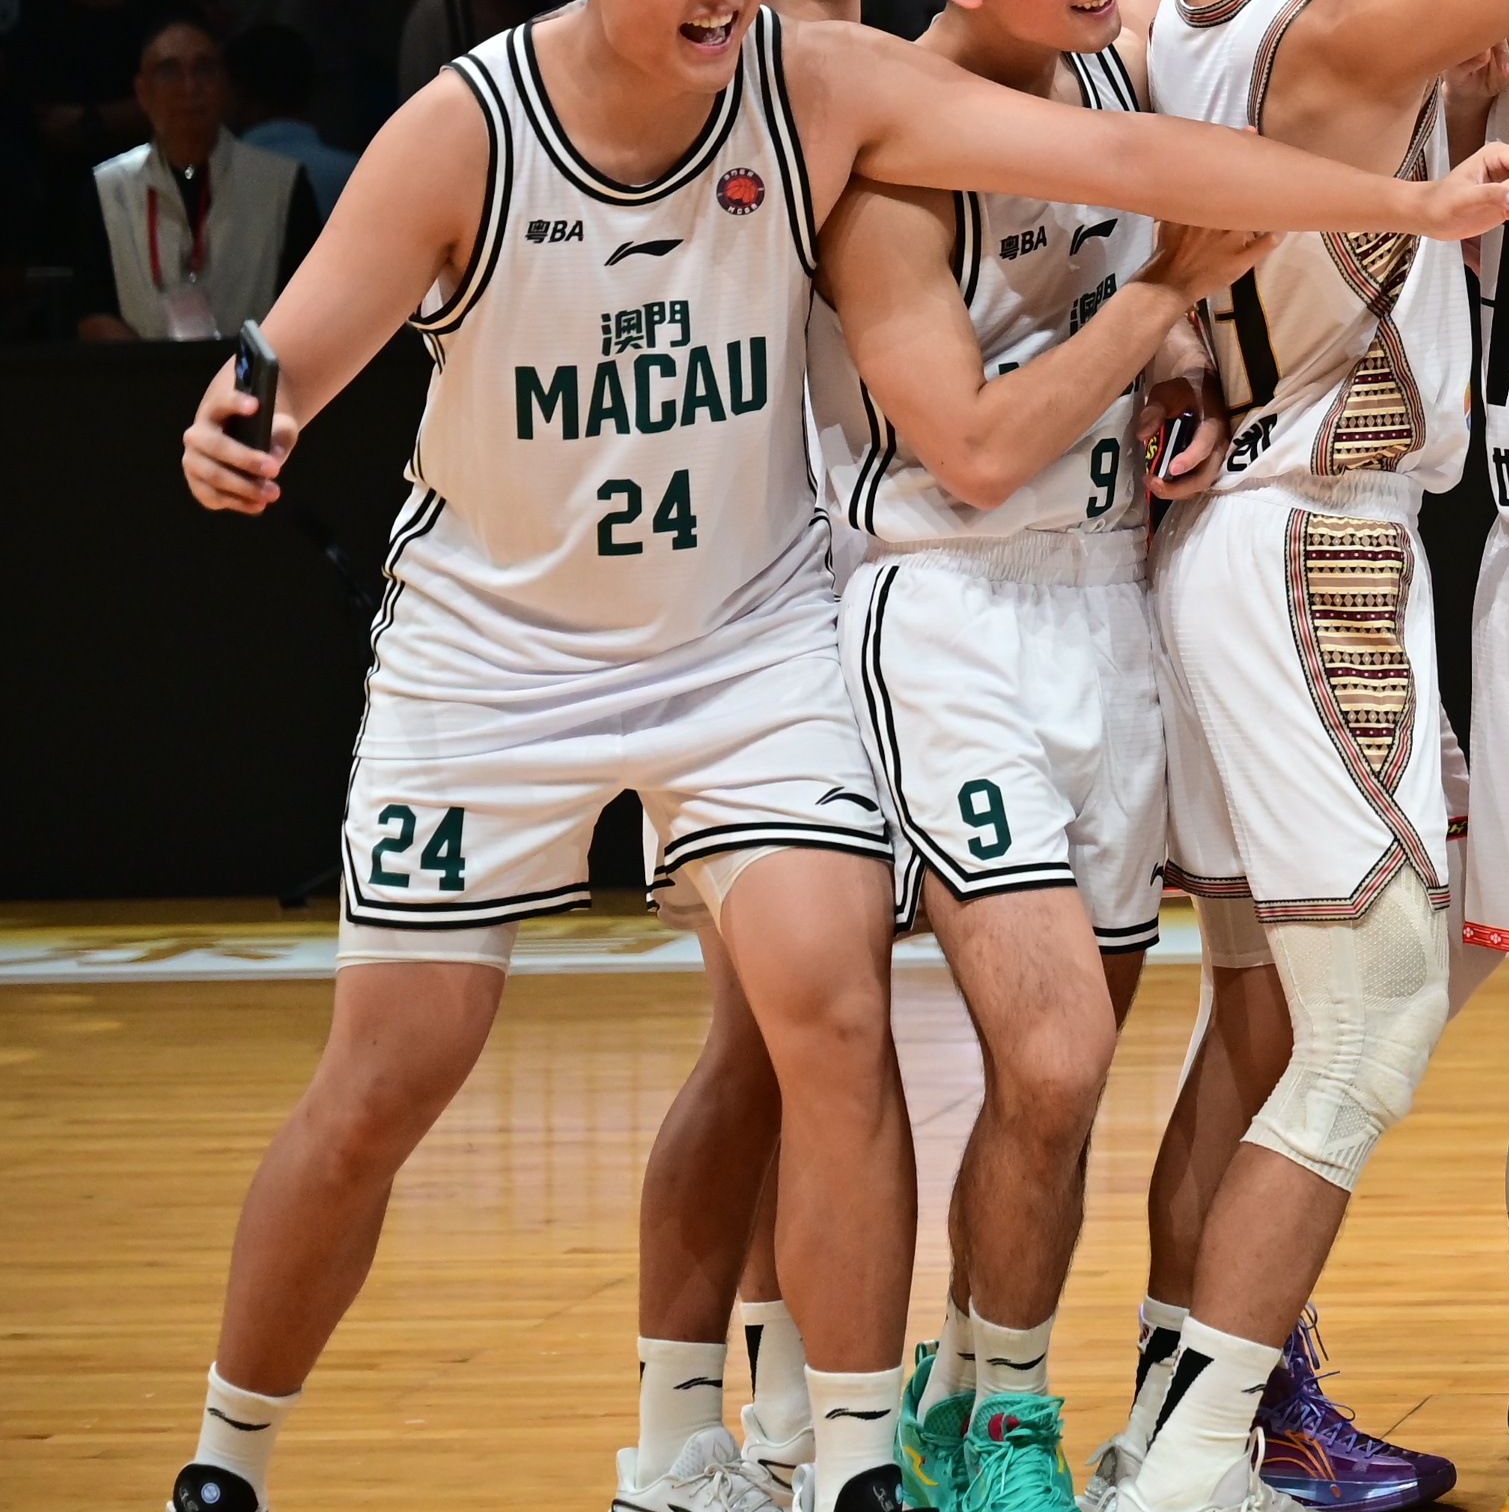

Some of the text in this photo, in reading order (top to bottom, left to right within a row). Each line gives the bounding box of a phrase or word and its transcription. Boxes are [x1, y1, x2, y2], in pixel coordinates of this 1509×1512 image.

[525, 219, 584, 244] 粤BA
[999, 225, 1048, 261] 粤BA
[600, 300, 691, 357] 澳門
[514, 336, 768, 440] MACAU
[597, 469, 698, 556] 24
[1086, 437, 1120, 519] 9
[368, 803, 466, 891] 24
[957, 778, 1012, 861] 9
